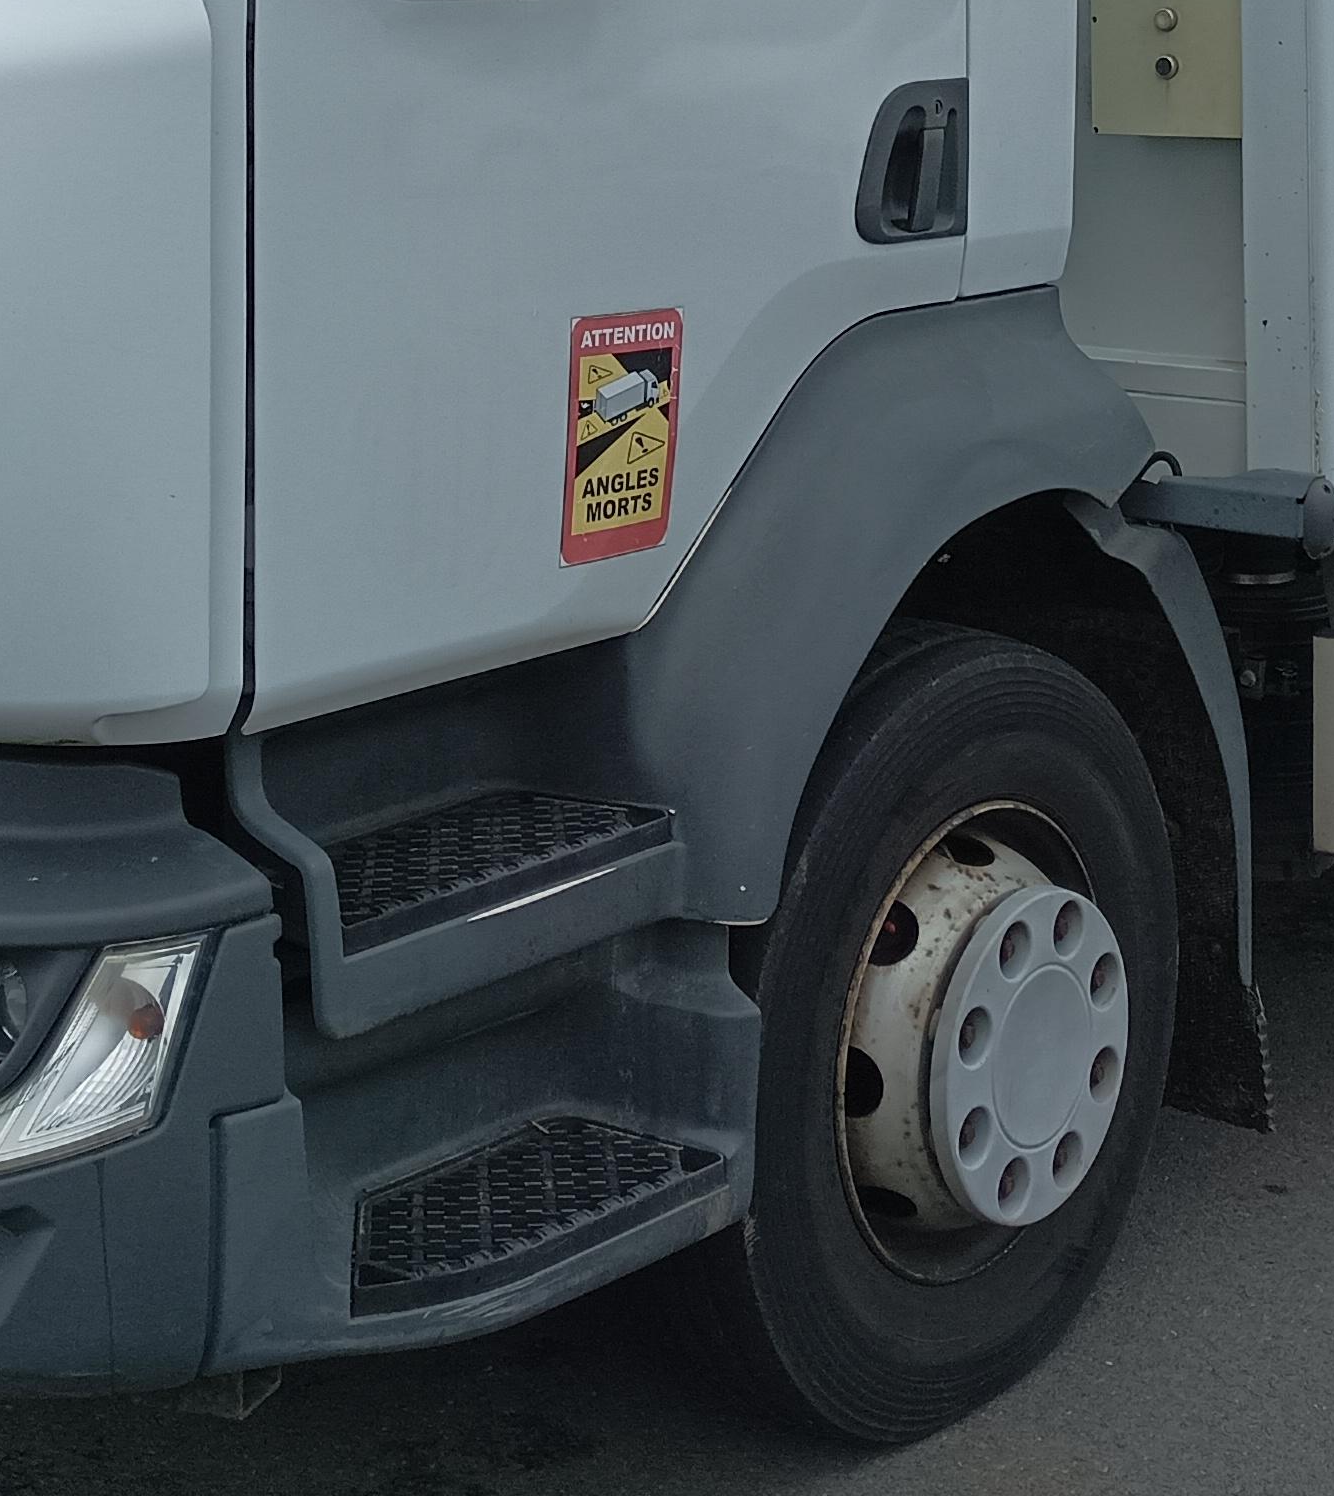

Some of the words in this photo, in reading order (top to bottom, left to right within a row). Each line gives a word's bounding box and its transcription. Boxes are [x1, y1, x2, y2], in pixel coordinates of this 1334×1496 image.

[580, 322, 675, 348] ATTENTION
[582, 467, 659, 499] ANGLES
[586, 492, 652, 523] MORTS
